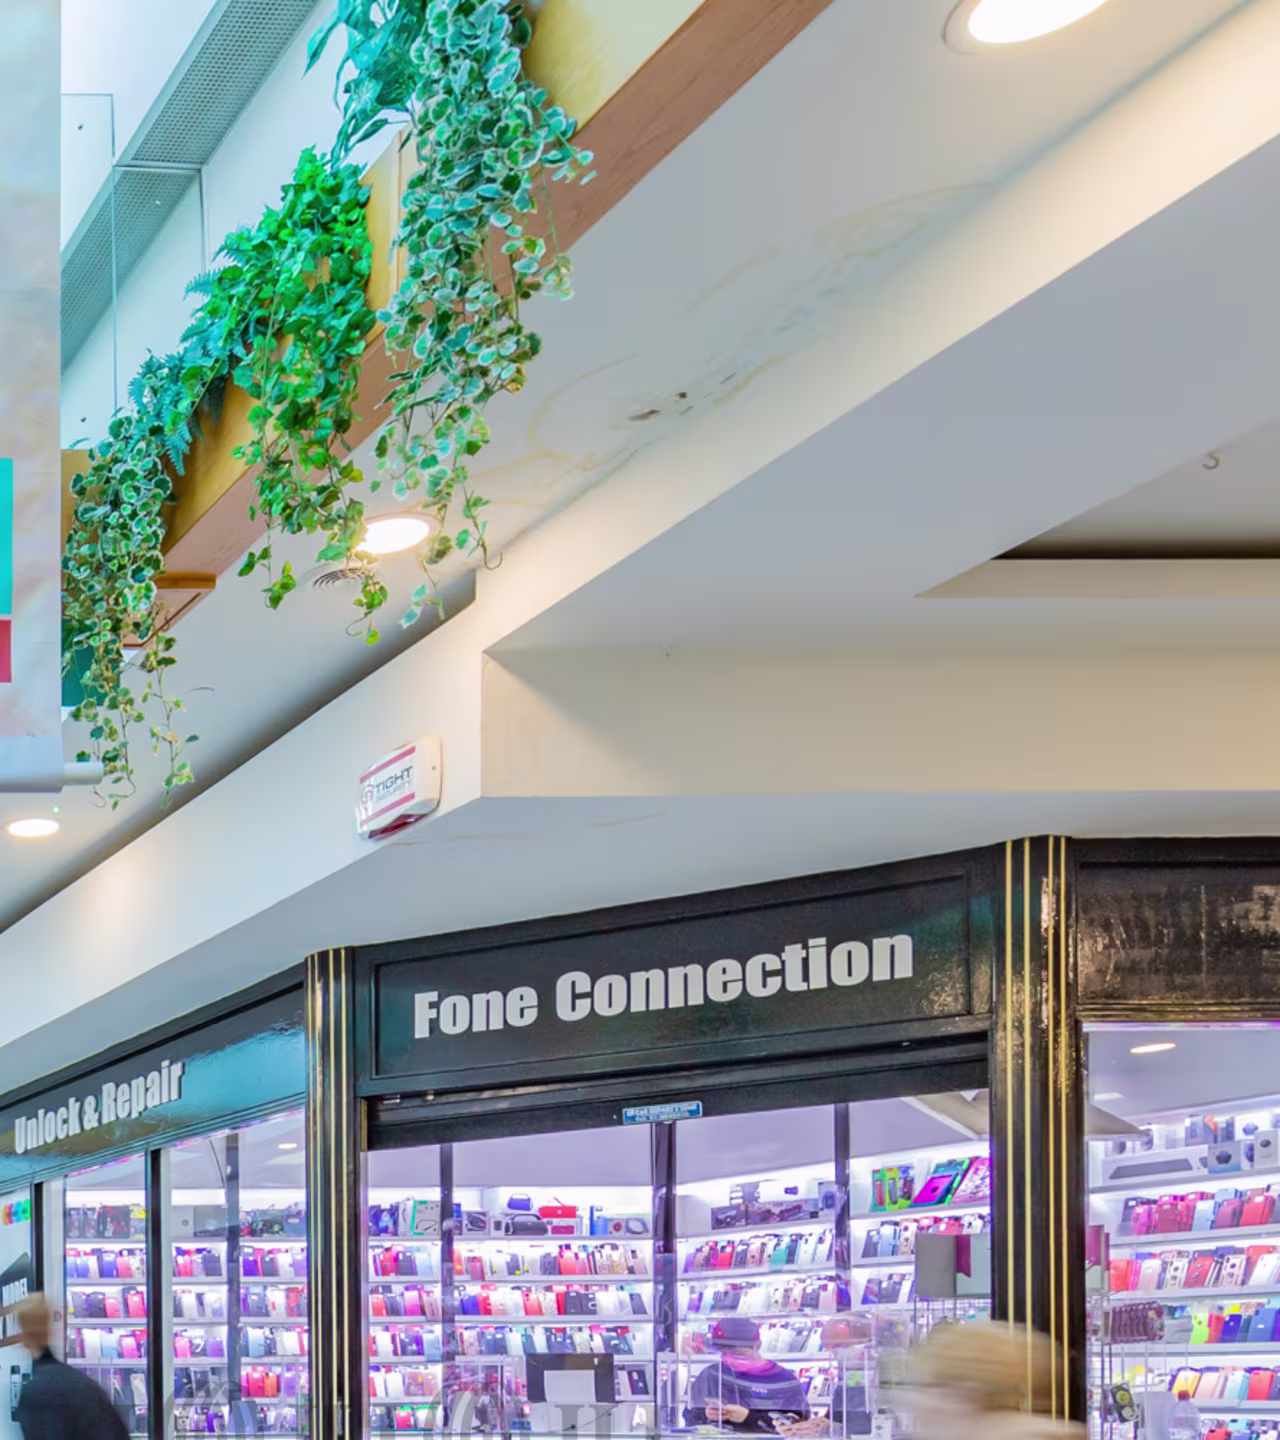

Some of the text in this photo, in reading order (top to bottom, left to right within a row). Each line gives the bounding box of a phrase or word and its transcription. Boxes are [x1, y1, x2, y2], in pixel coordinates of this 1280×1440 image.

[375, 765, 414, 794] TIGHT
[413, 933, 914, 1039] Fone Connection
[15, 1059, 186, 1155] Unlock & Repair
